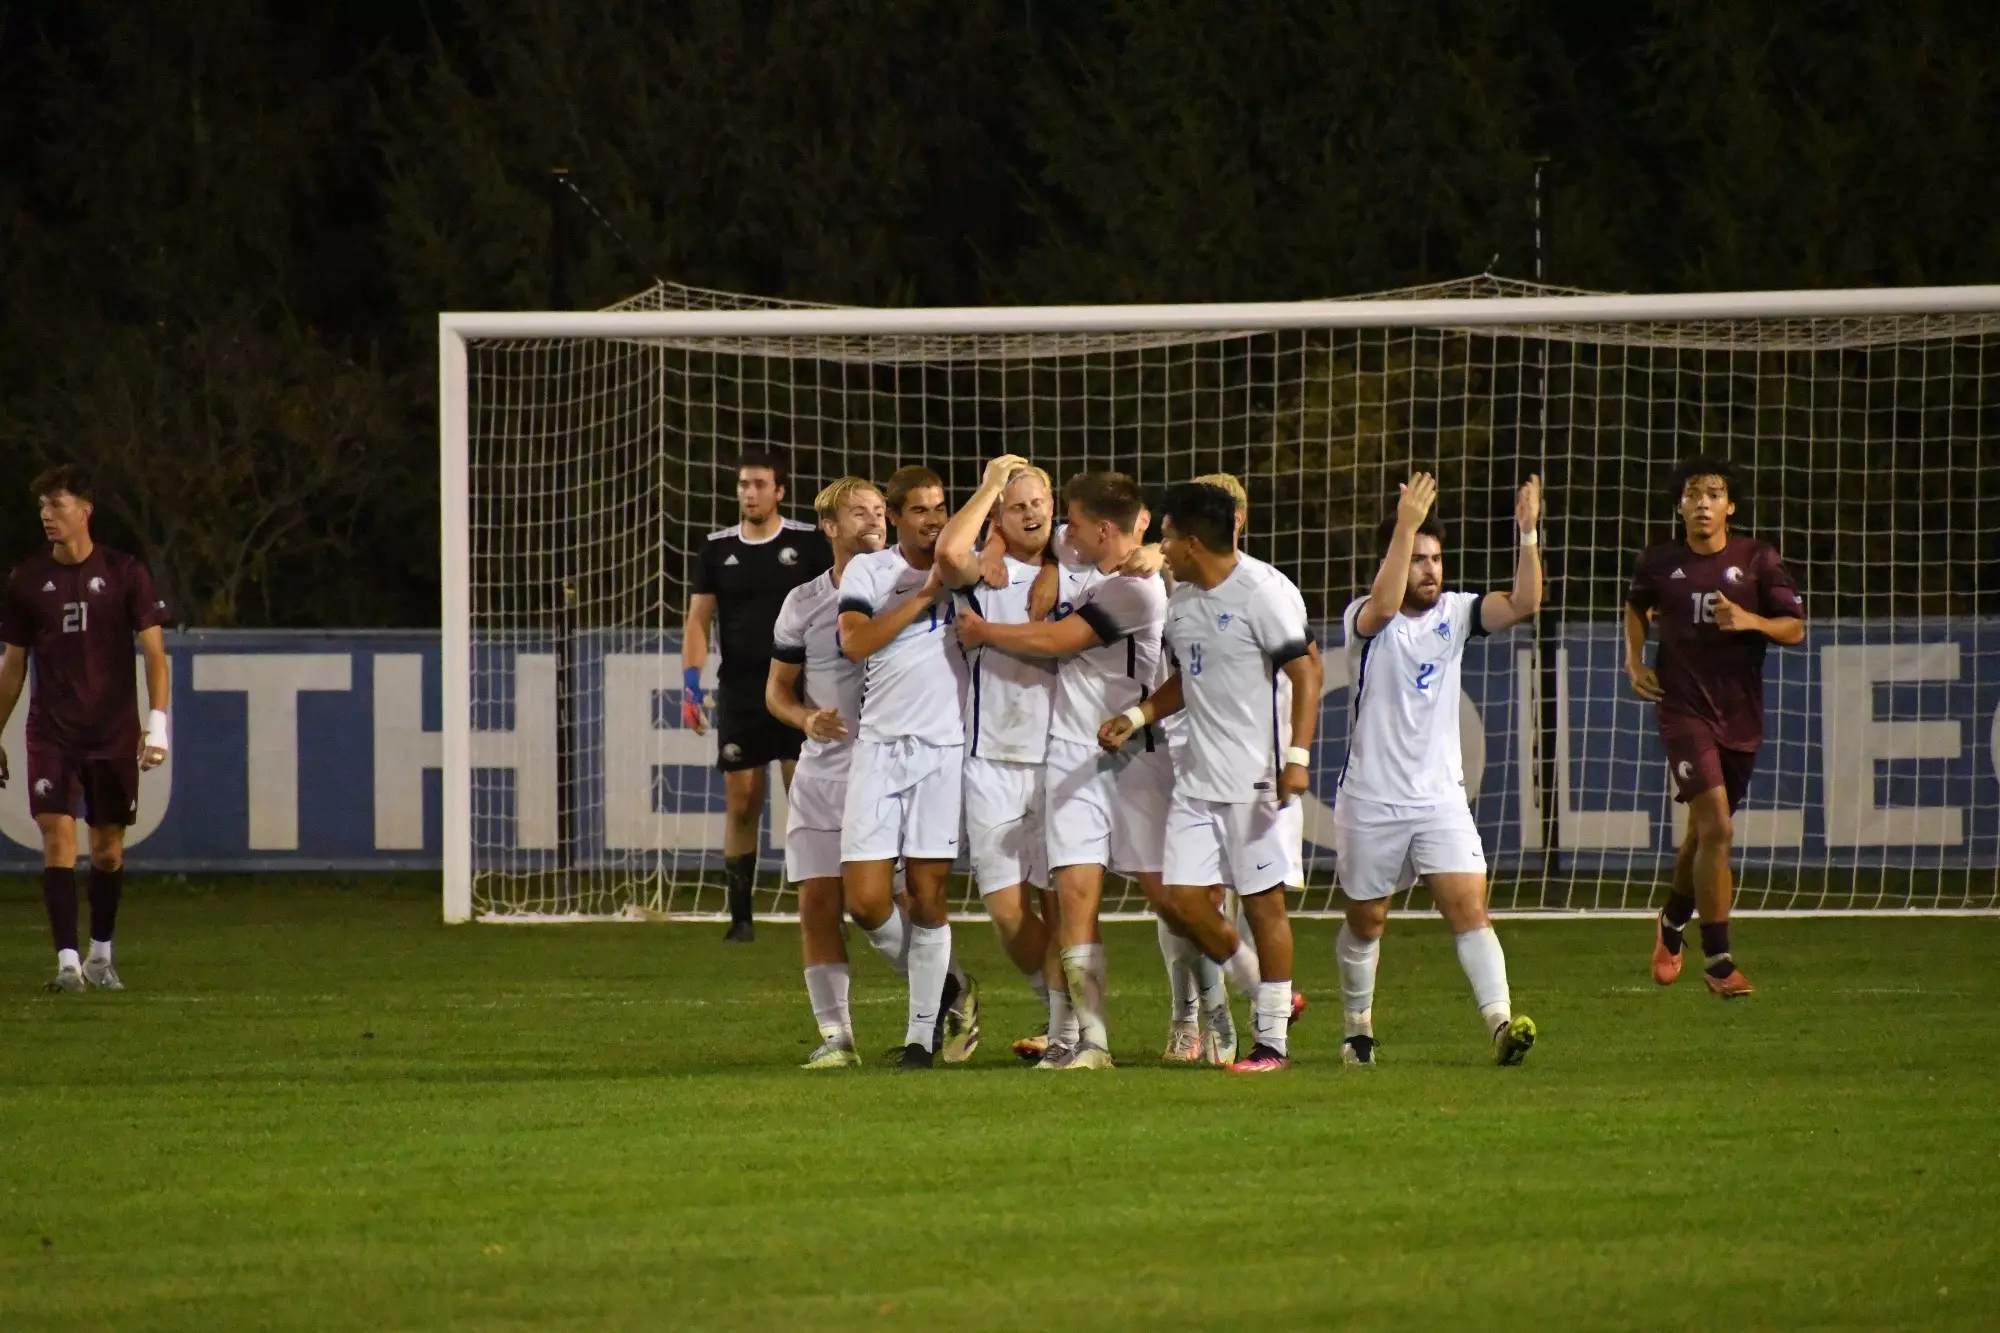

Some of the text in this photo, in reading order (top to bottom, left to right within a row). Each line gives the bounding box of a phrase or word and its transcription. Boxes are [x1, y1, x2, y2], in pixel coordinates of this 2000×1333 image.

[62, 600, 89, 633] 21
[1416, 663, 1435, 690] 2
[0, 651, 792, 855] UTHE
